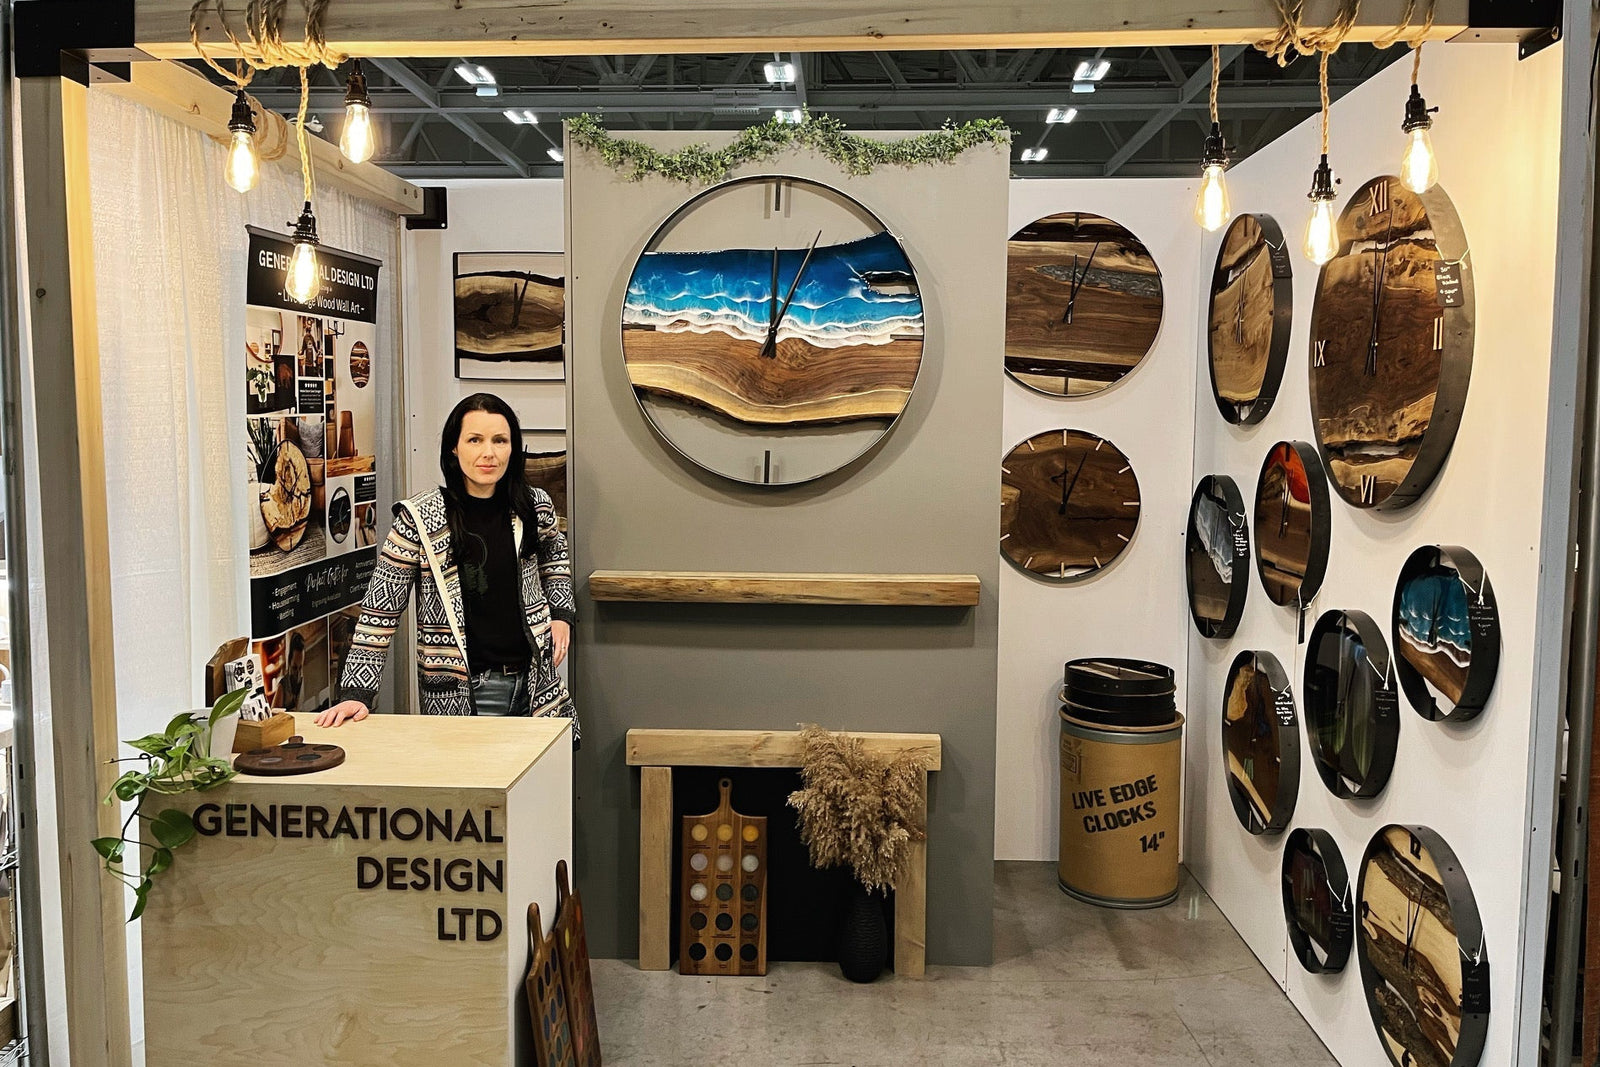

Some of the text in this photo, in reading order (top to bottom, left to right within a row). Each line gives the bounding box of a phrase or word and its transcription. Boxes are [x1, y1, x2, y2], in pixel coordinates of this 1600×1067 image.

[1369, 180, 1388, 217] XII
[258, 249, 374, 291] GENERAL DESIGN LTD
[317, 295, 336, 310] Wood
[336, 298, 350, 313] Wall
[350, 301, 361, 315] Art
[1313, 339, 1326, 368] IX
[1360, 474, 1375, 505] VI
[1072, 774, 1159, 810] LIVE EDGE
[192, 803, 504, 843] GENERATIONAL
[1082, 800, 1157, 833] CLOCKS
[356, 856, 503, 893] DESIGN
[437, 907, 503, 942] LTD
